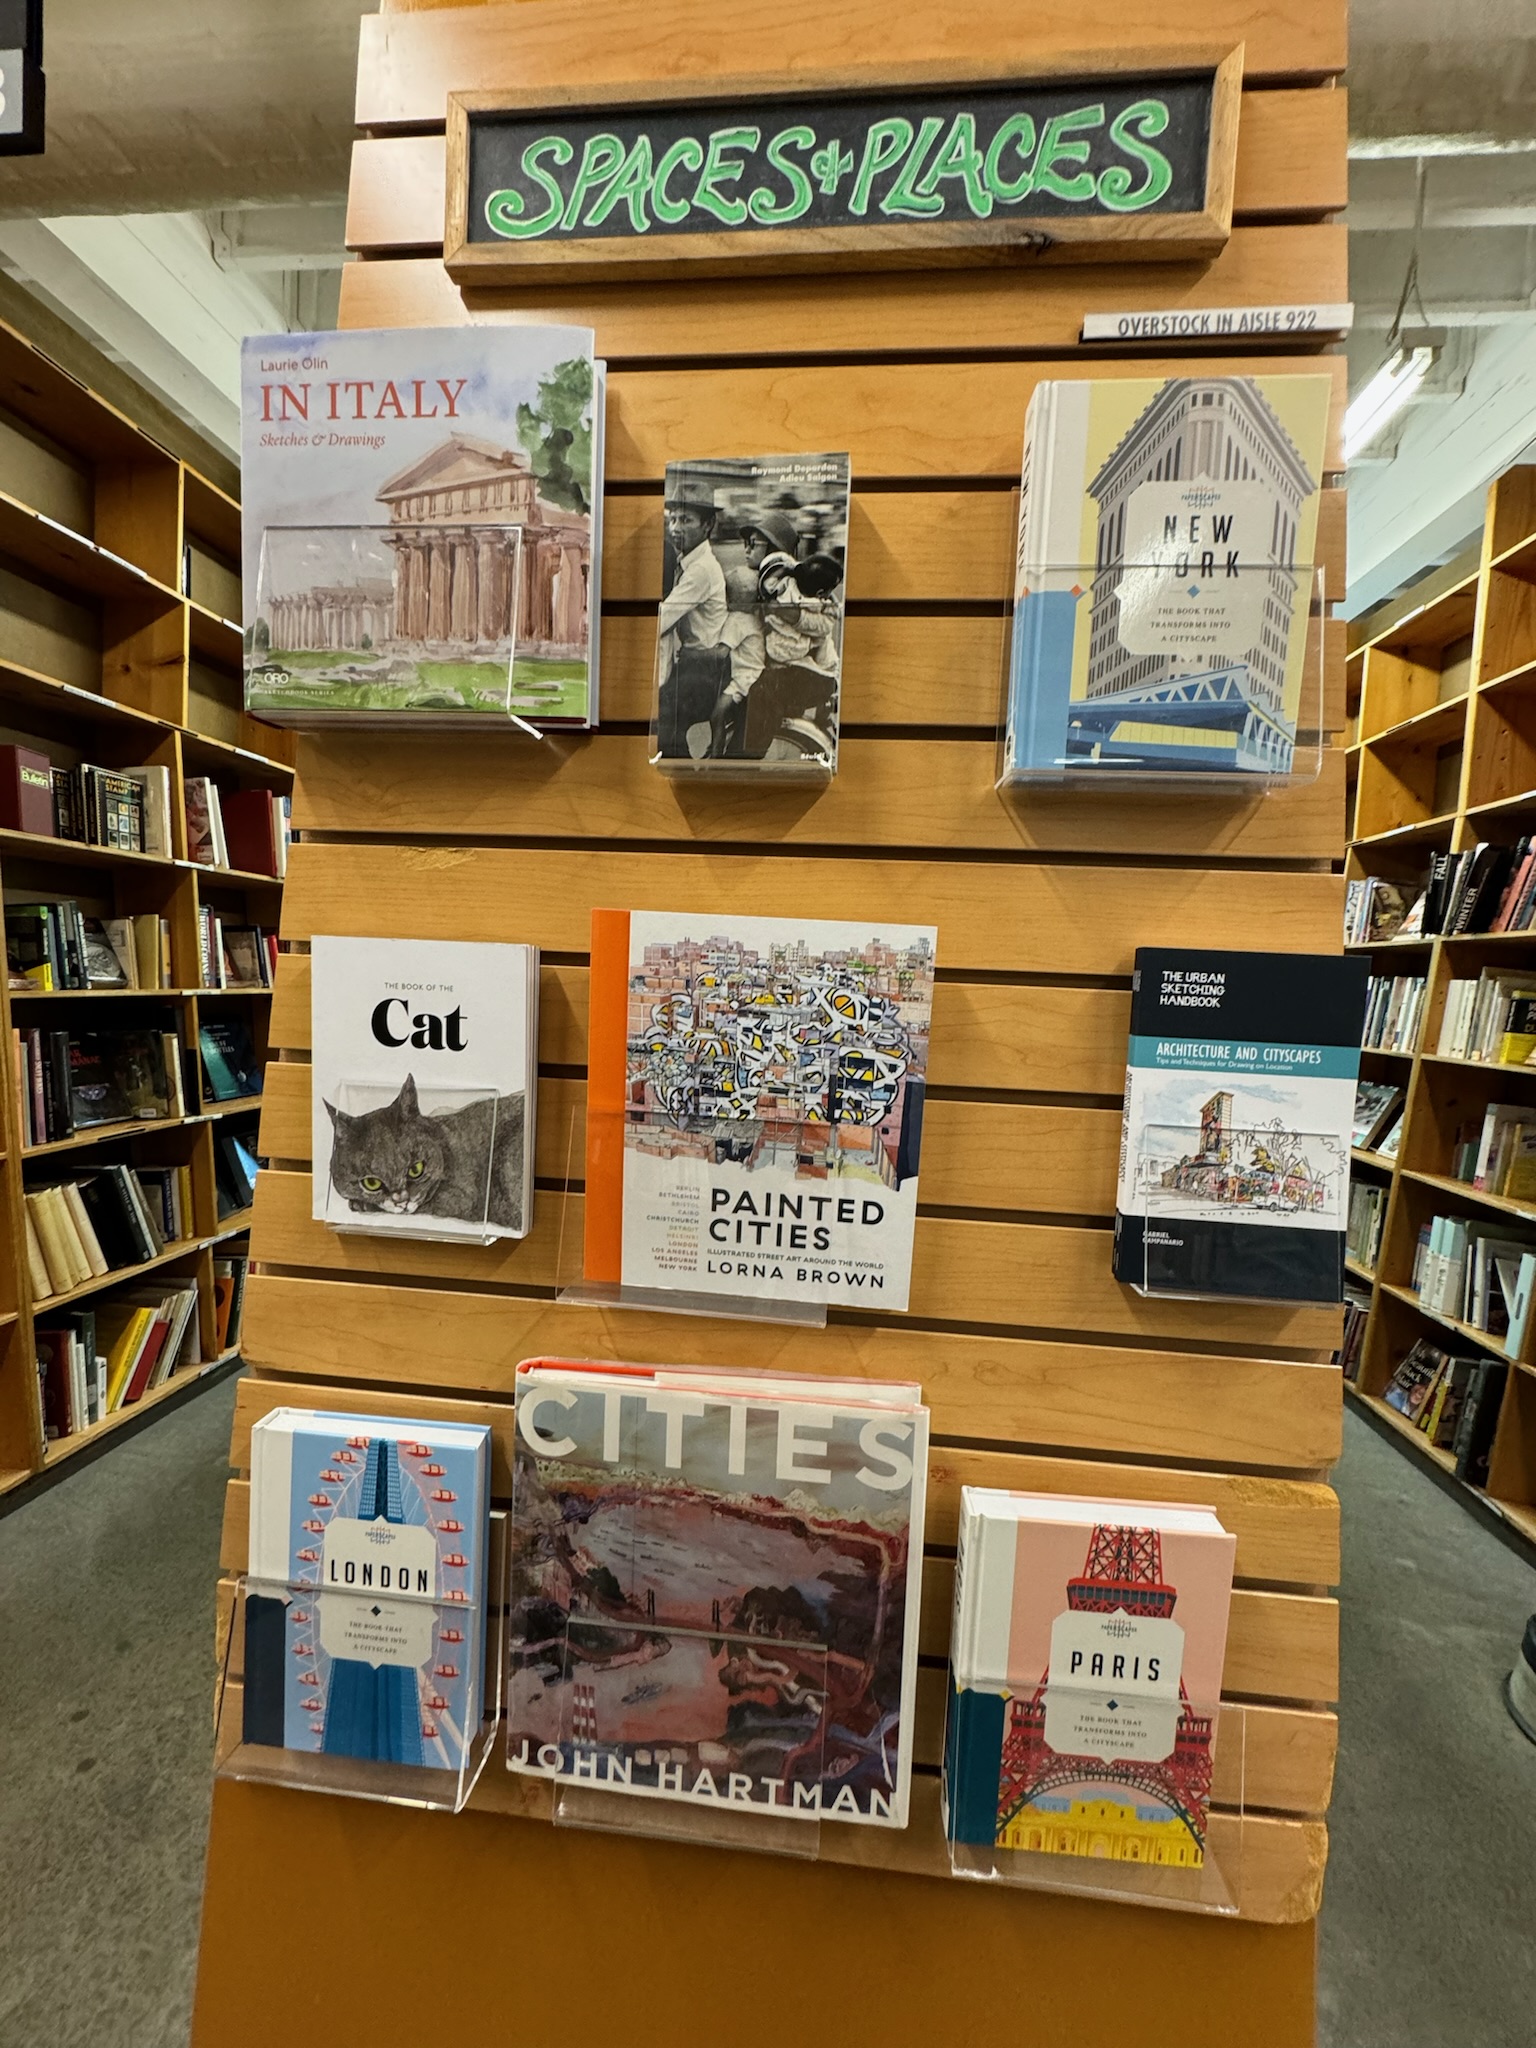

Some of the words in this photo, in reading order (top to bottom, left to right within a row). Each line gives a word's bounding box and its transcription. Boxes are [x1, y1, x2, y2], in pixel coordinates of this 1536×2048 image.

[485, 126, 813, 239] SPACES
[848, 99, 1173, 218] PLACES
[1117, 314, 1210, 337] OVERSTOCK
[1216, 313, 1234, 333] IN
[1239, 311, 1281, 332] AISLE
[1285, 310, 1317, 330] 922
[260, 358, 299, 372] Laurie
[301, 357, 328, 371] Olin
[260, 383, 312, 422] IN
[326, 378, 468, 420] ITALY
[259, 433, 308, 447] Sketches
[311, 434, 326, 445] &
[328, 432, 386, 450] Drawings
[751, 465, 793, 475] Raymond
[794, 463, 838, 473] Depardon
[780, 474, 804, 483] Adieu
[806, 473, 838, 483] Saigon
[1163, 515, 1234, 544] NEW
[1151, 551, 1240, 578] YORK
[1158, 607, 1174, 615] THE
[1176, 607, 1200, 615] BOOK
[1204, 607, 1226, 615] THAT
[1150, 621, 1207, 629] TRANSFORMS
[1210, 621, 1231, 629] INTO
[1170, 635, 1217, 643] CITYSCAPE
[1434, 855, 1449, 880] FALL
[1455, 888, 1478, 930] WINTER
[1162, 971, 1184, 982] THE
[1185, 972, 1226, 985] URBAN
[384, 982, 399, 990] THE
[401, 983, 424, 991] BOOK
[439, 984, 454, 992] THE
[1161, 983, 1226, 996] SKETCHING
[1159, 995, 1221, 1008] HANDBOOK
[371, 998, 469, 1052] Cat
[1156, 1042, 1231, 1060] ARCHITECTURE
[1235, 1047, 1258, 1061] AND
[1263, 1048, 1322, 1065] CITYSCAPES
[1156, 1057, 1170, 1065] Tips
[1183, 1058, 1216, 1068] Techniques
[1228, 1061, 1255, 1071] Drawing
[1265, 1063, 1293, 1071] Location
[659, 1192, 700, 1200] BETHLEHEM
[710, 1188, 885, 1225] PAINTED
[646, 1214, 699, 1224] CHRISTCHURCH
[709, 1218, 831, 1250] CITIES
[1142, 1230, 1170, 1239] GABRIEL
[1142, 1237, 1184, 1246] CAMPANARIO
[654, 1255, 697, 1264] MELBOURNE
[707, 1249, 755, 1259] ILLUSTRATED
[757, 1252, 785, 1261] STREET
[786, 1255, 802, 1263] ART
[803, 1257, 837, 1266] AROUND
[854, 1261, 884, 1270] WORLD
[707, 1260, 784, 1280] LORNA
[797, 1268, 884, 1289] BROWN
[517, 1386, 915, 1491] CITIES
[331, 1559, 428, 1592] LONDON
[349, 1621, 361, 1629] THE
[364, 1623, 382, 1631] BOOK
[385, 1625, 402, 1633] THAT
[344, 1632, 388, 1642] TRANSFORMS
[390, 1637, 408, 1645] INTO
[360, 1645, 397, 1654] CITYSCAPE
[1070, 1651, 1160, 1681] PARIS
[1098, 1717, 1119, 1725] BOOK
[1122, 1718, 1142, 1726] THAT
[1074, 1725, 1125, 1736] TRANSFORMS
[1127, 1730, 1147, 1738] INTO
[1091, 1739, 1134, 1748] CITYSCAPE
[511, 1739, 633, 1785] JOHN
[658, 1763, 897, 1819] HARTMAN
